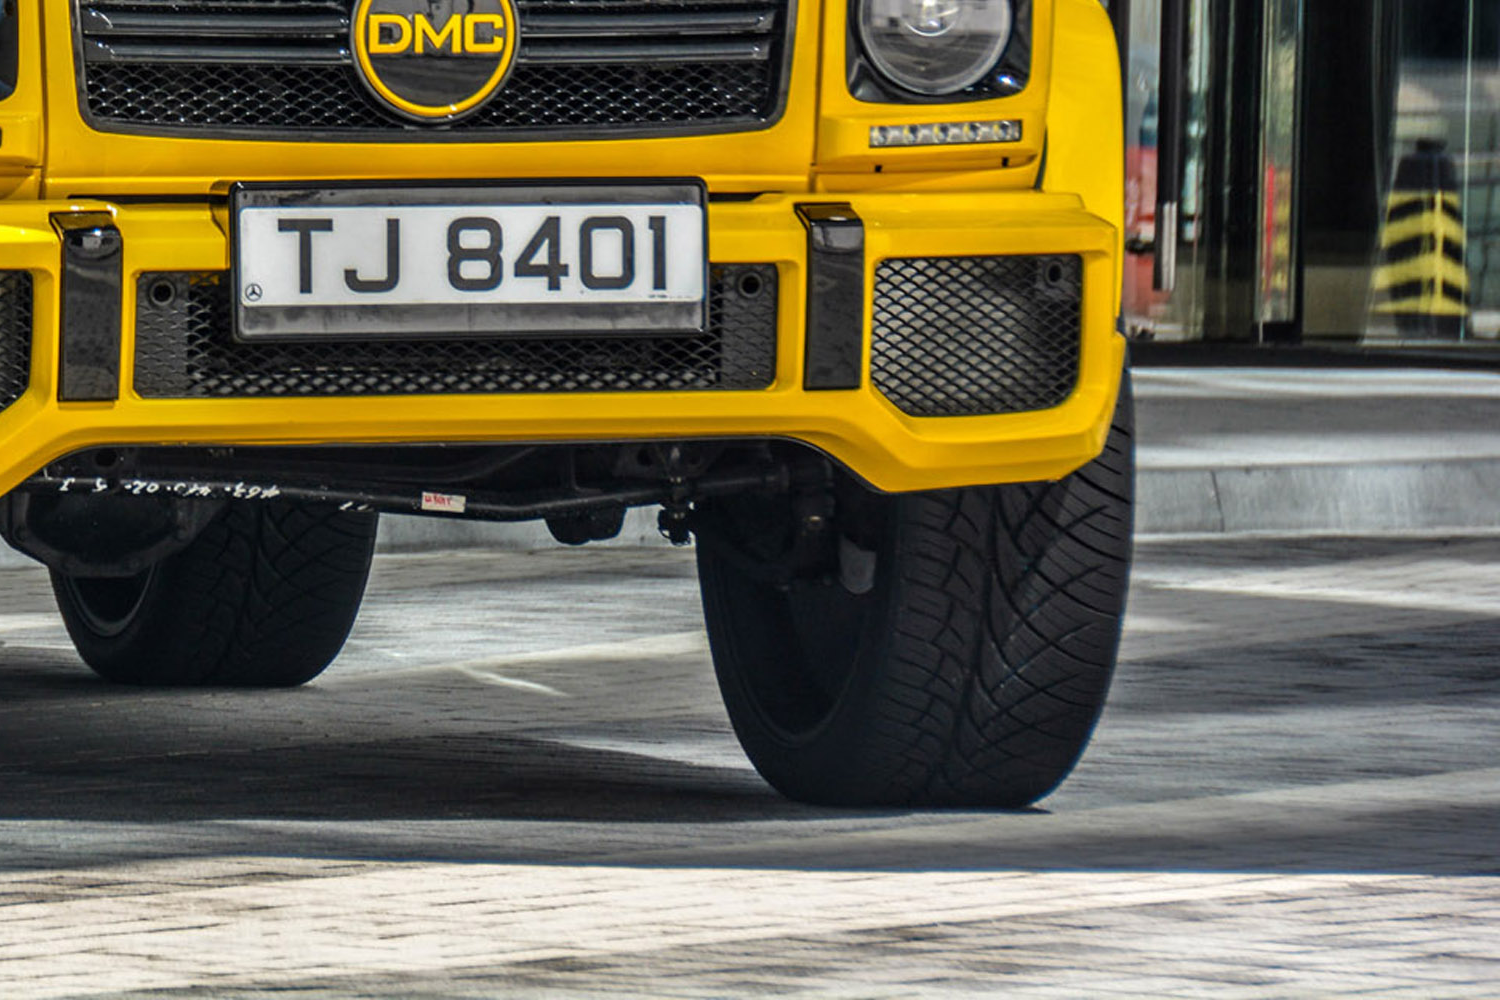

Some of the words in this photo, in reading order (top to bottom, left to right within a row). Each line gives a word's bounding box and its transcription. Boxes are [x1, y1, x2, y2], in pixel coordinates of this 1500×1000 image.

[369, 13, 504, 54] DMC
[277, 217, 401, 294] TJ
[447, 215, 667, 292] 8401
